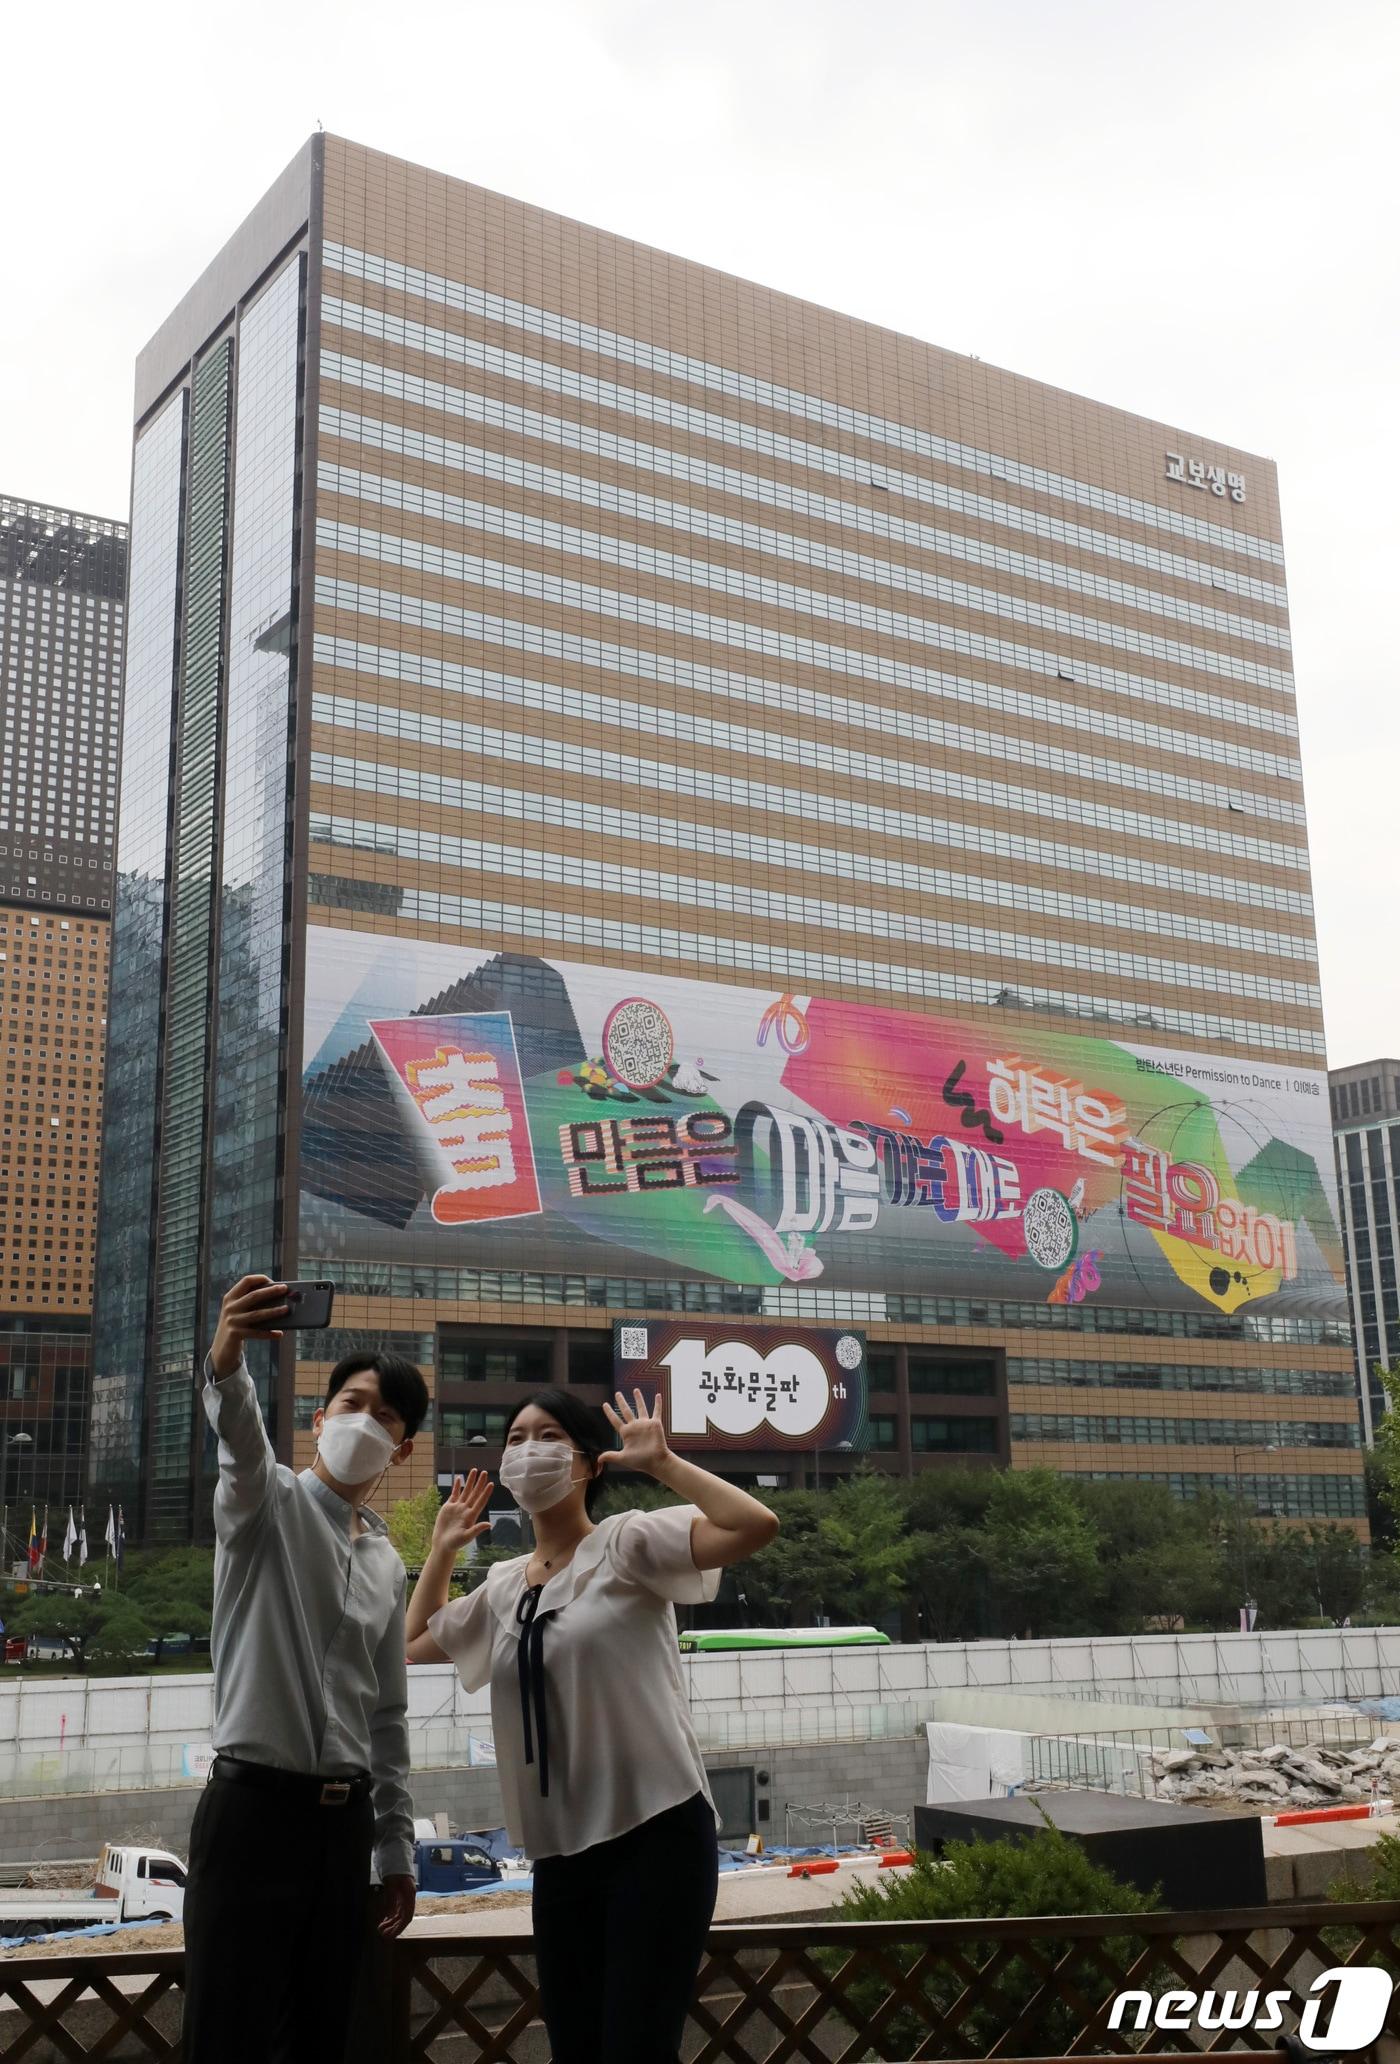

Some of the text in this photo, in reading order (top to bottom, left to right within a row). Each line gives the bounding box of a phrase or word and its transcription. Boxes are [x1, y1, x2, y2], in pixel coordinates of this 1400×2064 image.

[1166, 451, 1246, 503] 교보생명
[1135, 1057, 1320, 1096] 방탄소년단 Permission to Dance 이예승
[986, 1052, 1130, 1167] 허락은
[699, 1366, 800, 1412] 광화문글판
